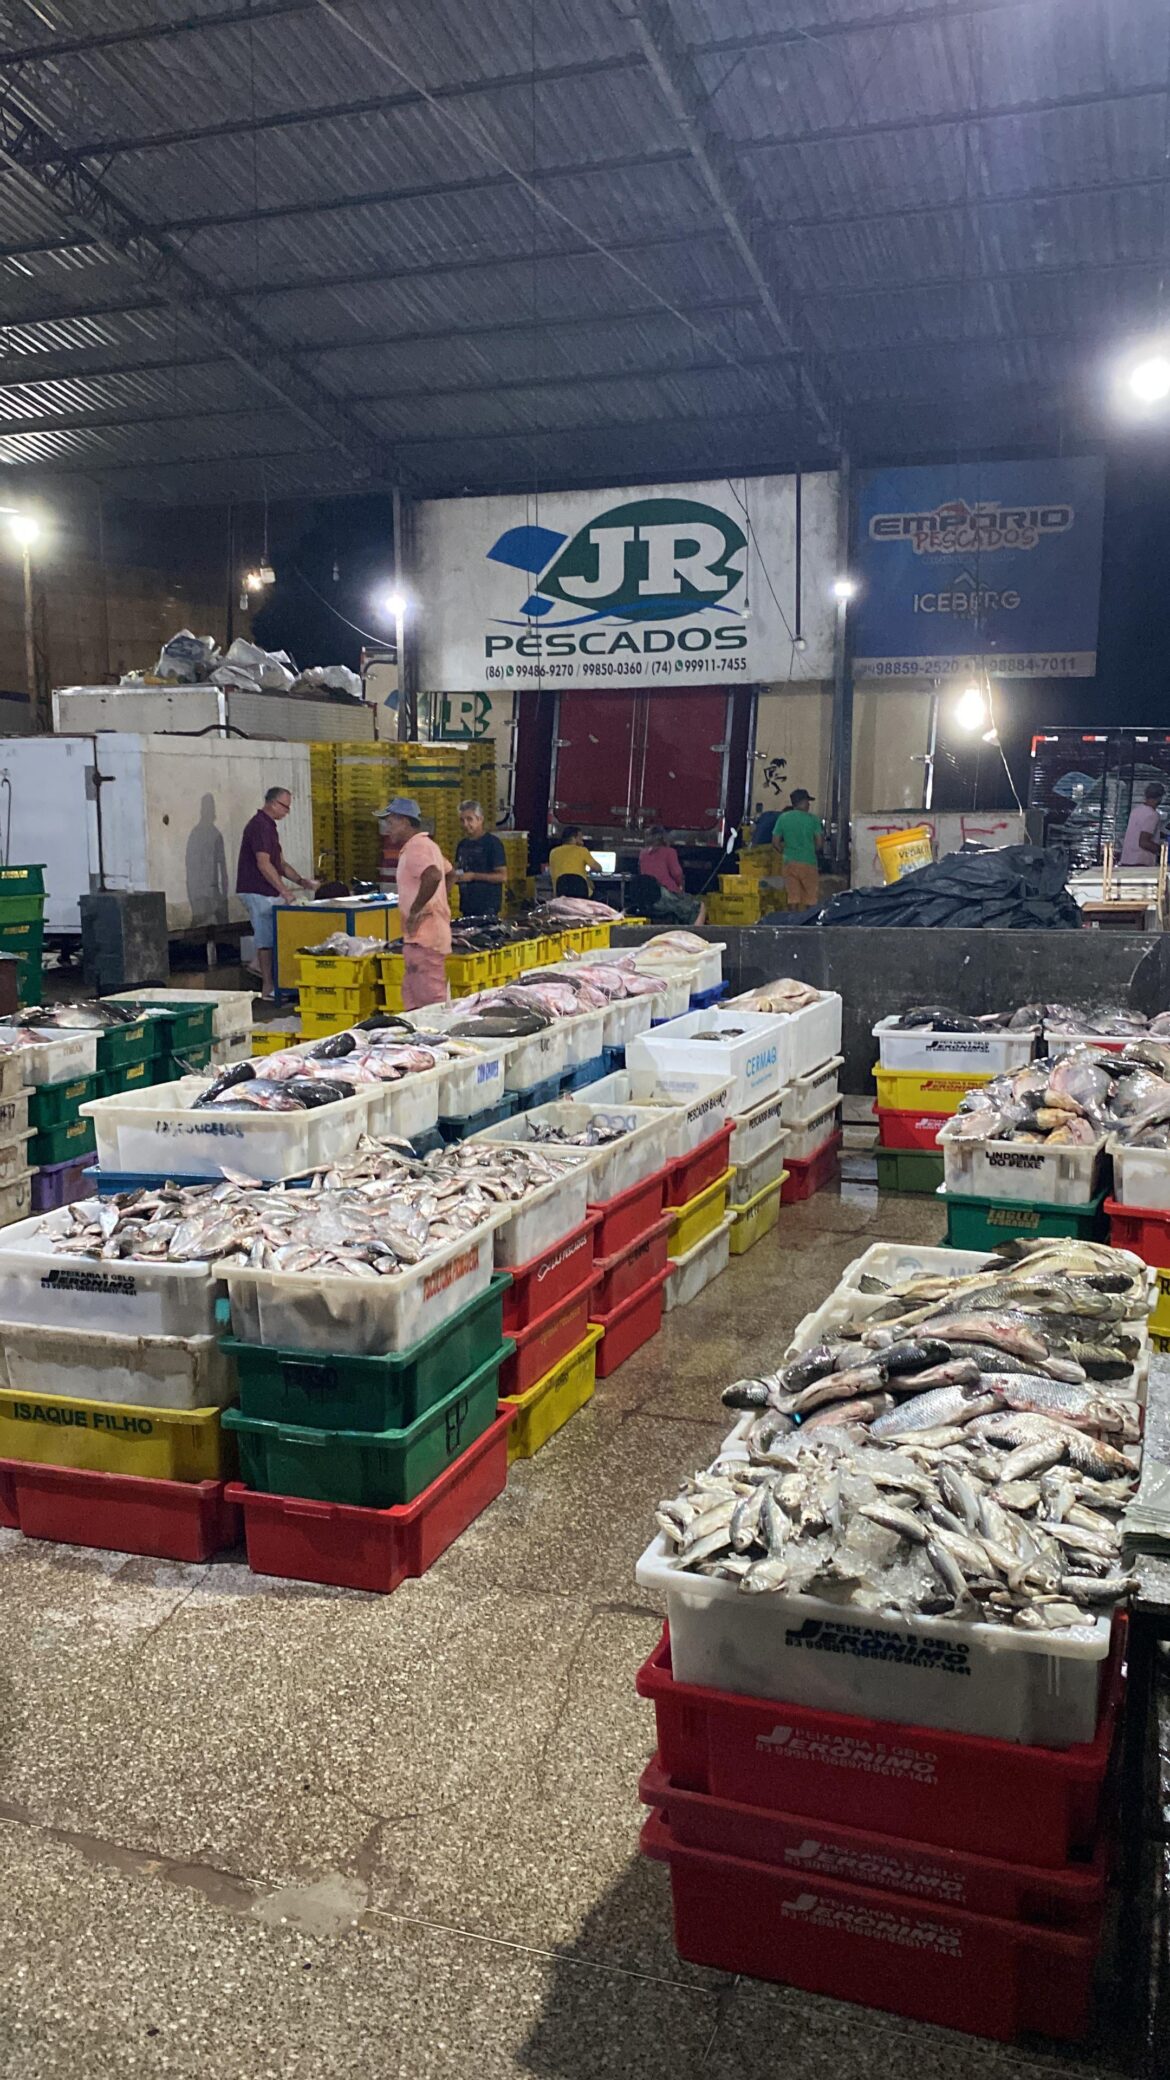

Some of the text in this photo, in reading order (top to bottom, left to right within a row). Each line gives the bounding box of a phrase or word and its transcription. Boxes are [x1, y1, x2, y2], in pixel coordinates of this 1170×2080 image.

[914, 527, 1036, 550] PESCADOS
[558, 522, 728, 598] JR
[913, 591, 1021, 613] ICEBERG
[485, 626, 748, 658] PESCADOS
[485, 666, 504, 681] (86)
[516, 664, 574, 678] 99486-9270
[583, 661, 642, 676] 99850-0360
[651, 660, 672, 676] (74)
[685, 658, 747, 672] 99911-7455
[985, 1151, 1045, 1163] LINDOMAR
[989, 1158, 1006, 1167] DO
[111, 1274, 135, 1283] GELO
[14, 1402, 153, 1435] ISAQUE FILHO
[824, 1622, 971, 1654] PEIXARIA E GELO
[795, 1728, 871, 1749] PEIXARIA
[893, 1746, 938, 1762] GELO
